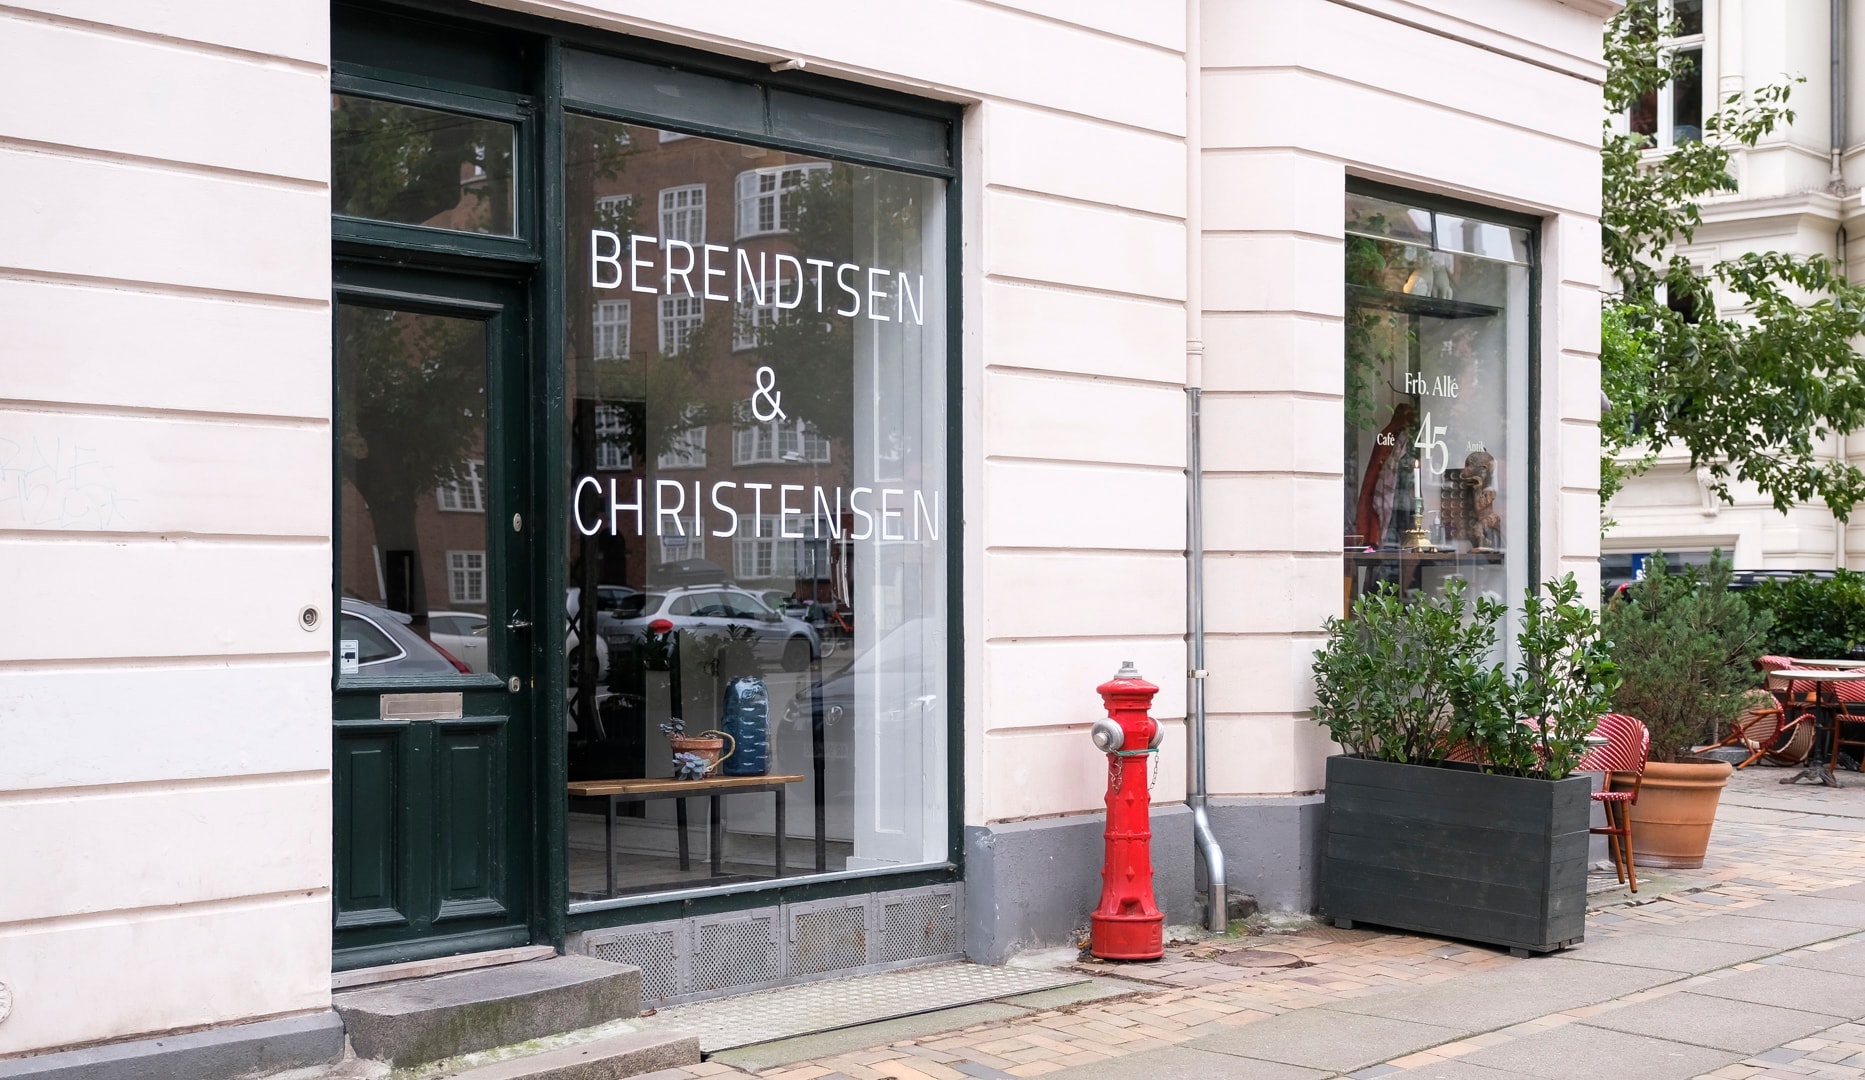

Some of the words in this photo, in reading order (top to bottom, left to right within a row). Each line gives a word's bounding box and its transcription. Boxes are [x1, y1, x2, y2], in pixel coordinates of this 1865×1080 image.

[591, 229, 924, 325] BERENDTSEN
[751, 366, 786, 422] &
[1405, 372, 1429, 395] Frb.
[1432, 375, 1459, 398] Allé
[1377, 432, 1395, 446] Café
[1414, 411, 1448, 475] 45
[1466, 441, 1485, 452] Antik
[574, 476, 940, 541] CHRISTENSEN
